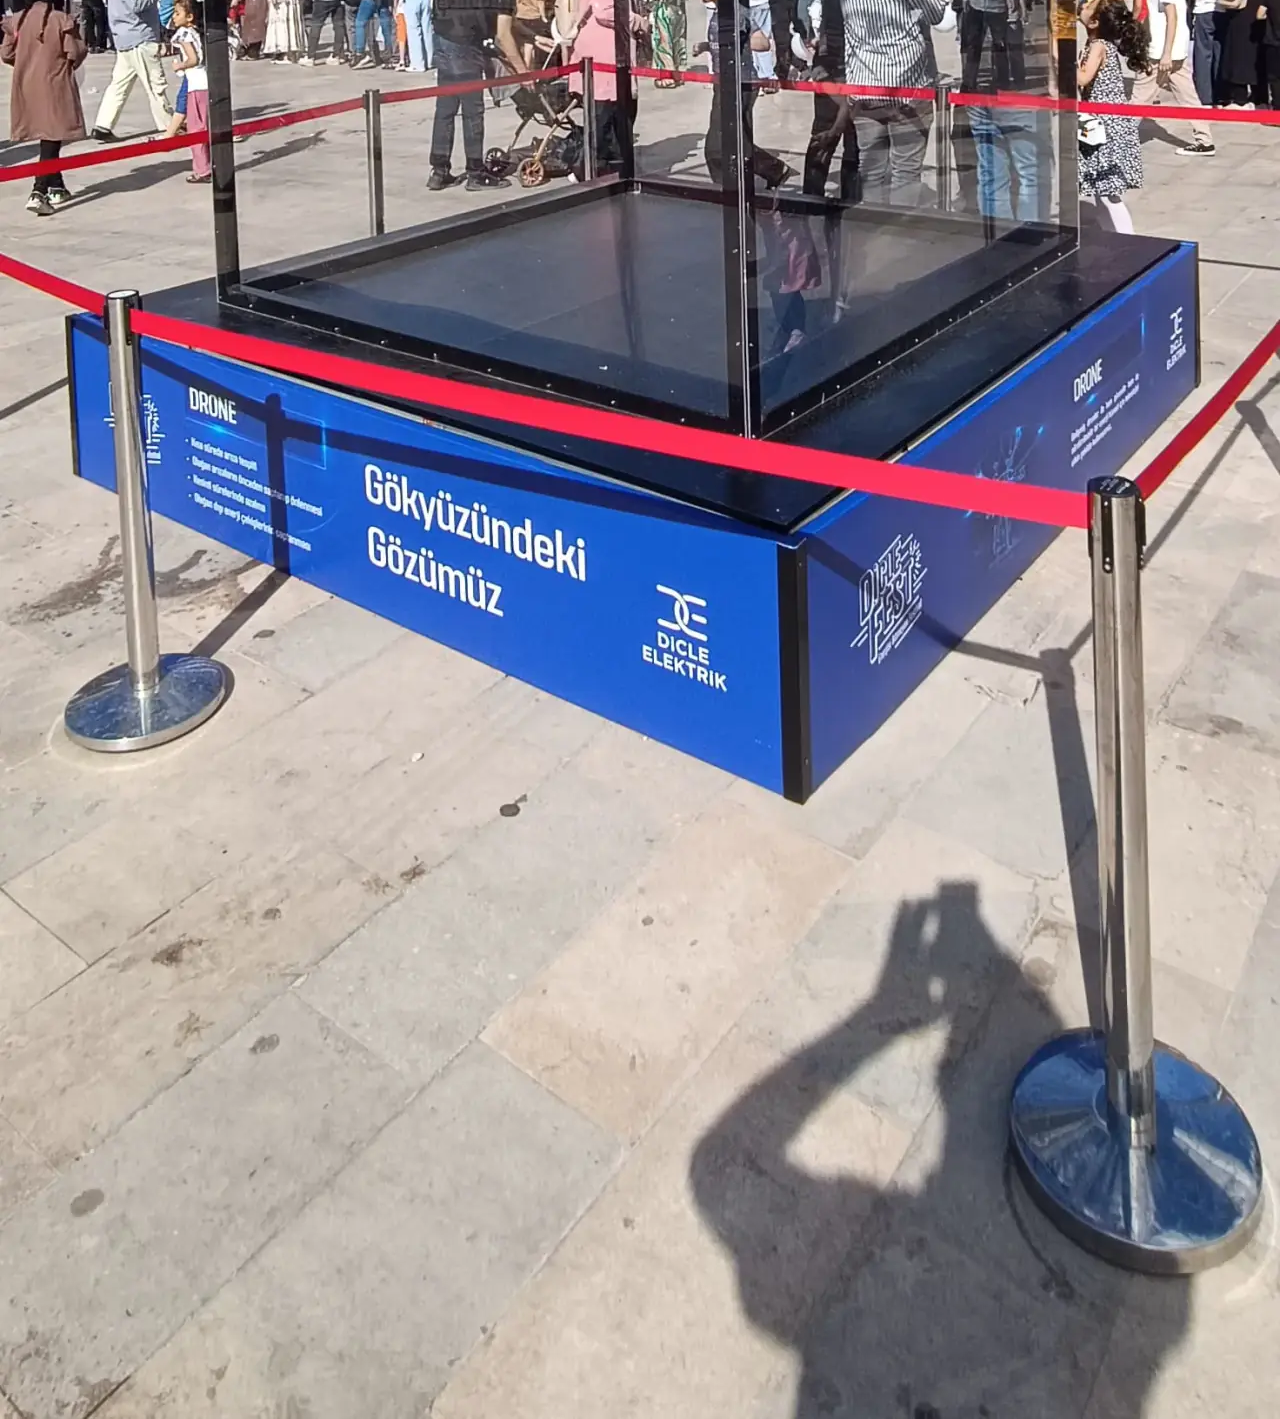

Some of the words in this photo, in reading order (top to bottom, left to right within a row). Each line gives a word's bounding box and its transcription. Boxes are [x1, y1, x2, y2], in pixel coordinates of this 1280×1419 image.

[188, 386, 237, 425] DRONE
[1073, 358, 1103, 403] DRONE
[364, 464, 586, 582] Gökyüzündeki
[367, 526, 504, 617] Gözümüz
